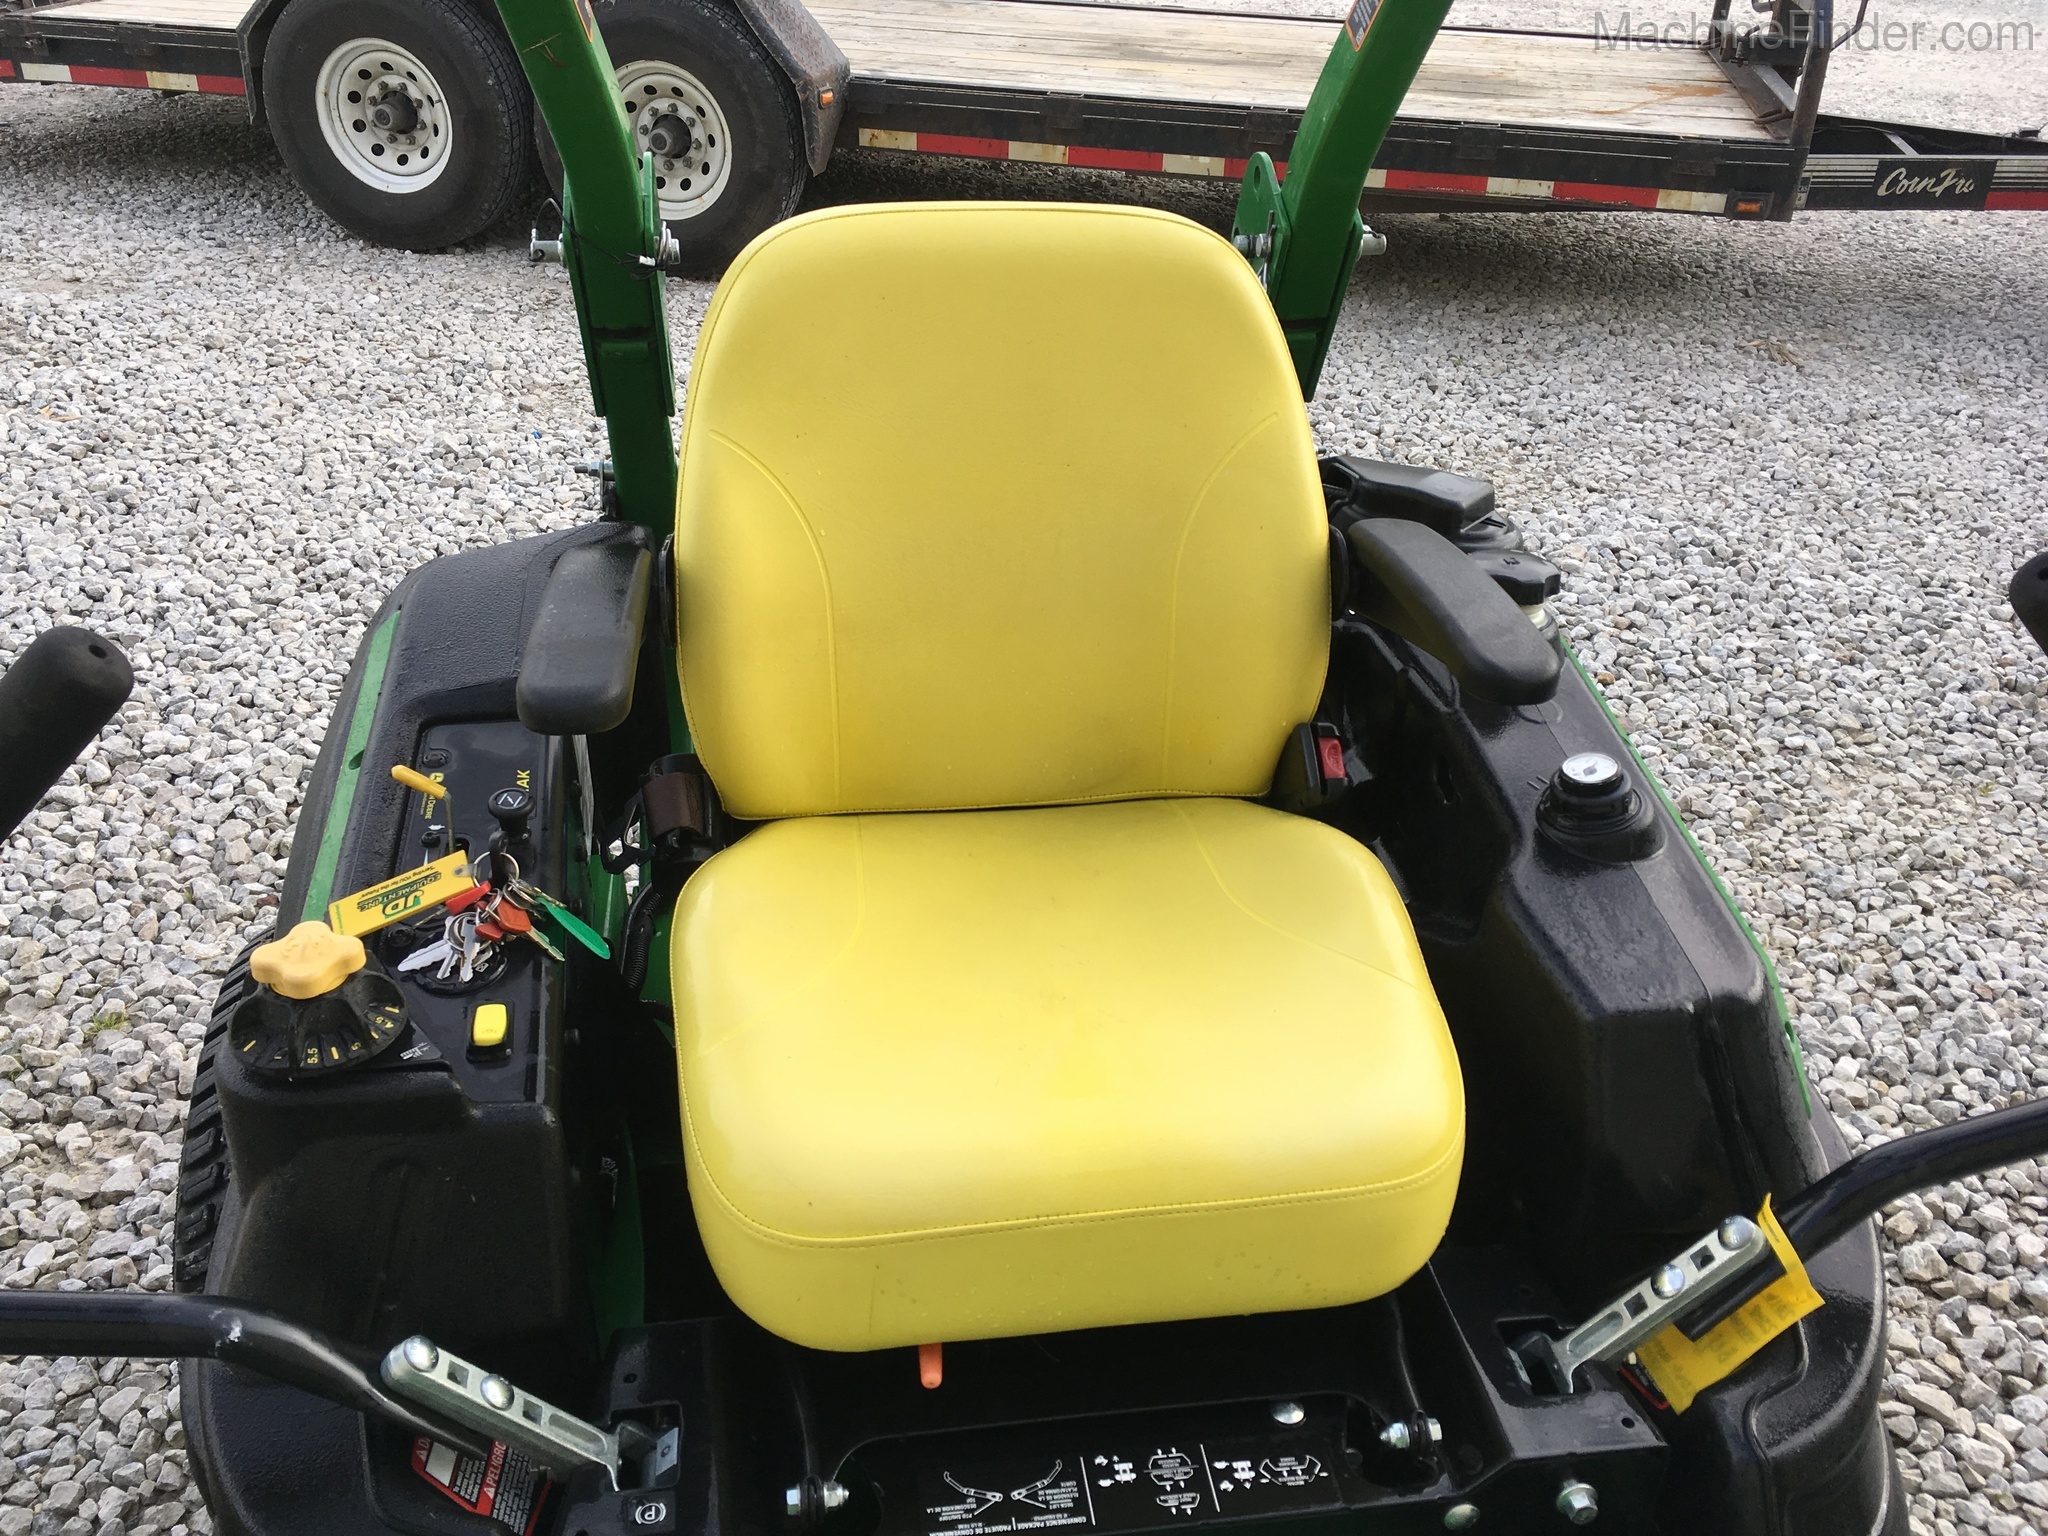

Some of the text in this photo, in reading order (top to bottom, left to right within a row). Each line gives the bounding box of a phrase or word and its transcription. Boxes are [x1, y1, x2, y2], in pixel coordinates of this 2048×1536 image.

[400, 875, 412, 883] YOU
[357, 872, 442, 912] EQUIPMENT INC.
[382, 890, 424, 916] JD
[307, 1048, 318, 1064] 5.5
[984, 1525, 1011, 1533] PAQUETE
[1017, 1516, 1086, 1530] CONVENIENCE PACKAGE
